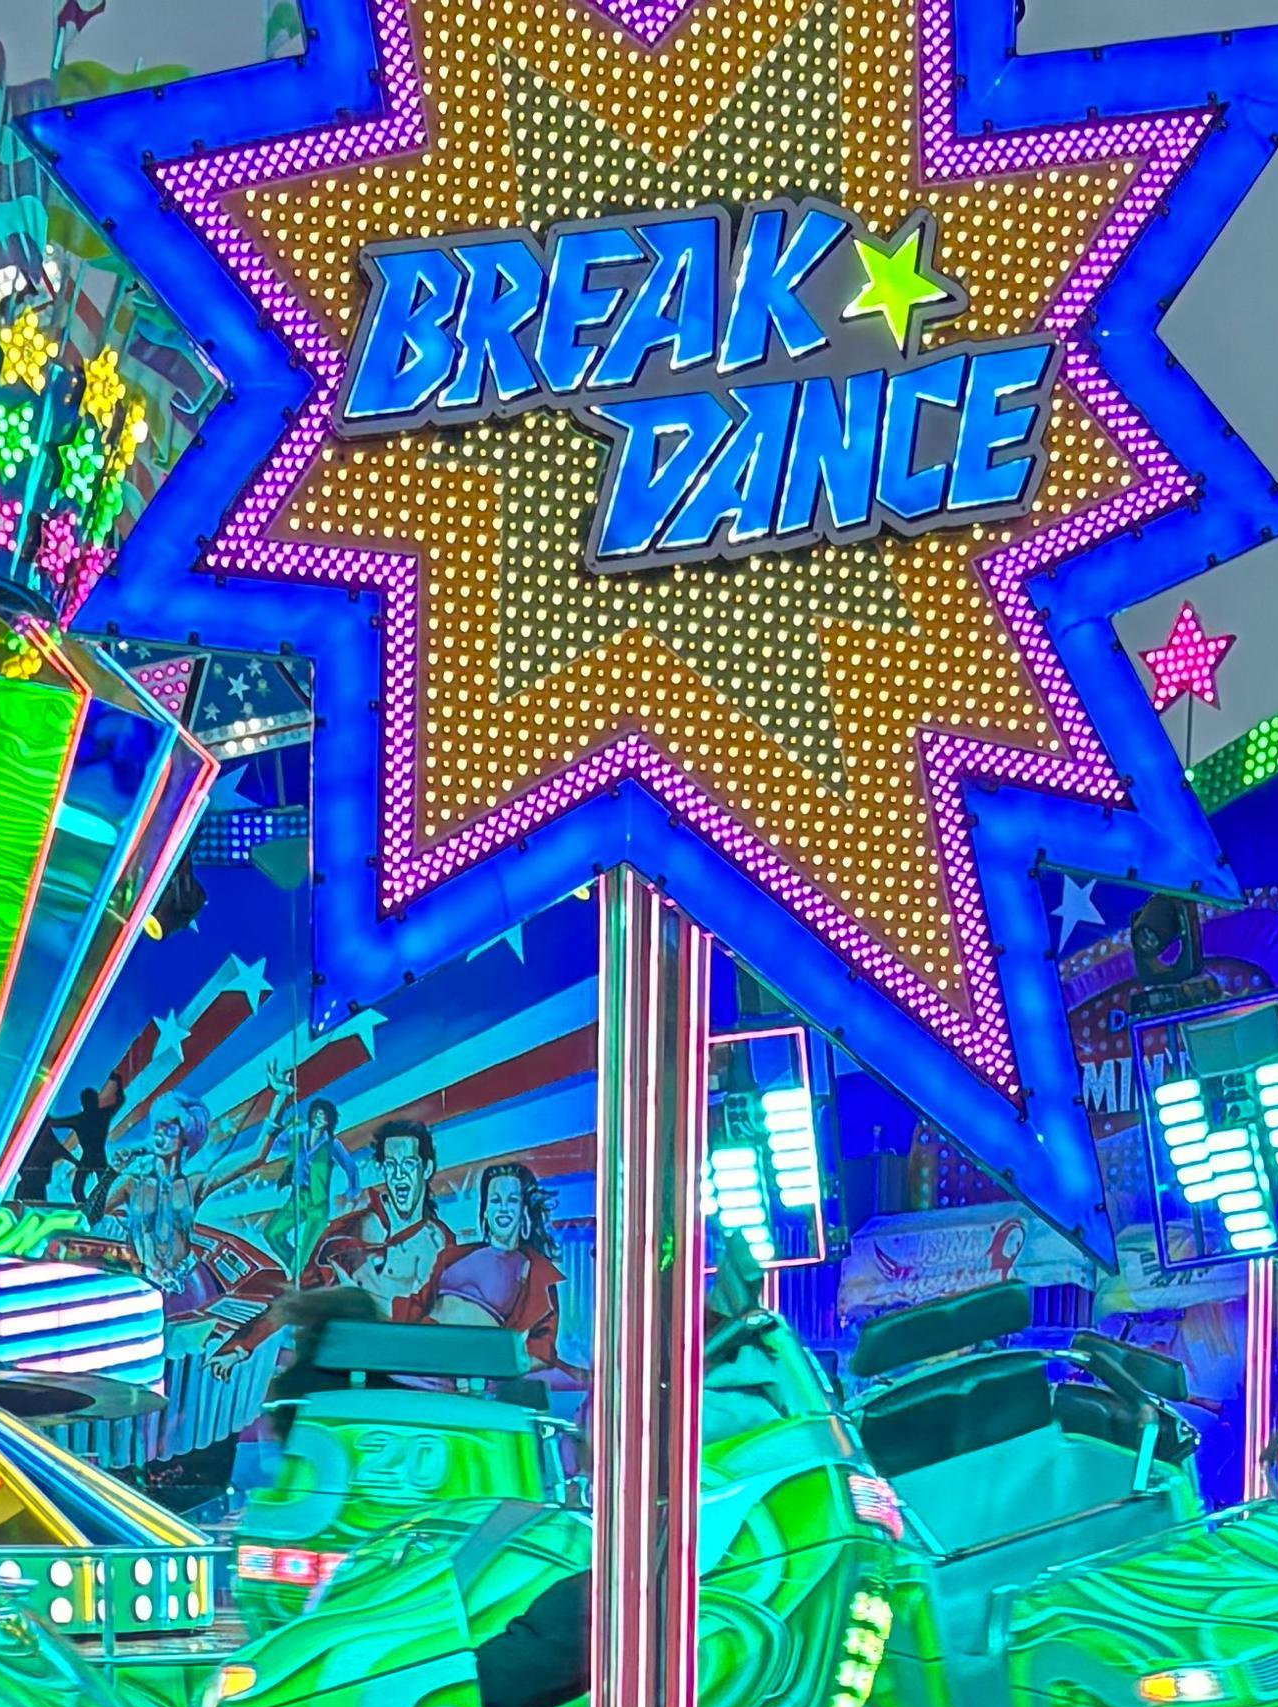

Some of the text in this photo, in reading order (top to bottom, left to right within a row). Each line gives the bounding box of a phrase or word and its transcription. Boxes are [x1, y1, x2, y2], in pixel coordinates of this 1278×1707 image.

[344, 209, 851, 420] BREAK
[588, 342, 1056, 562] DANCE
[348, 1430, 449, 1491] 20
